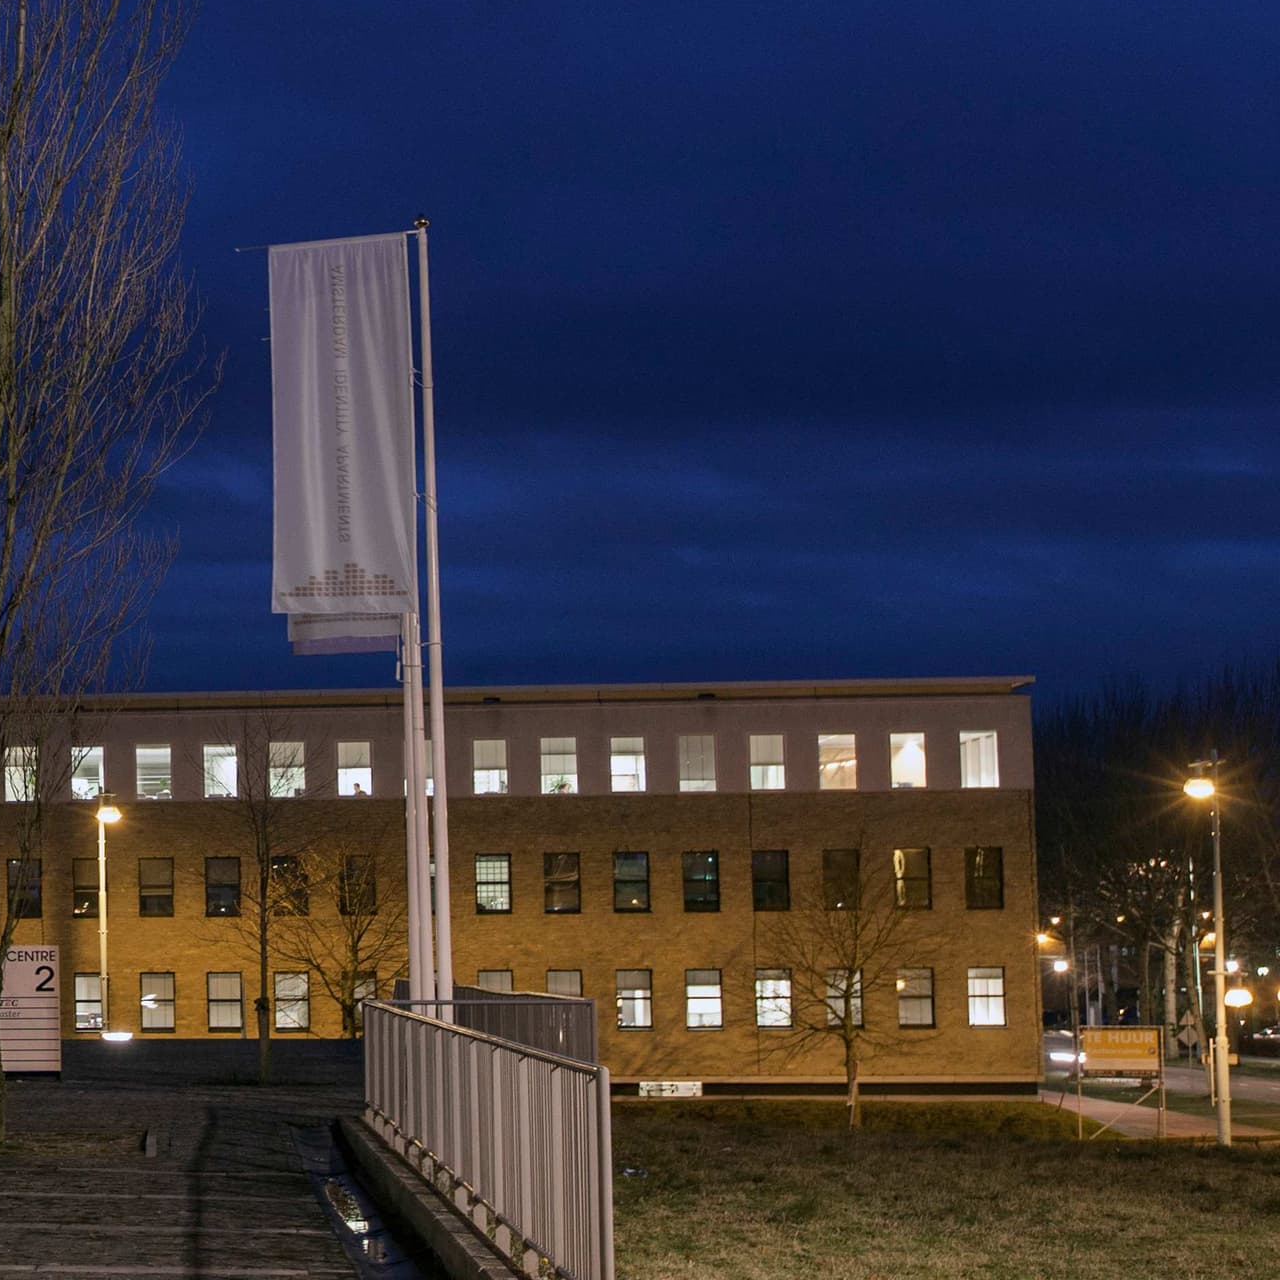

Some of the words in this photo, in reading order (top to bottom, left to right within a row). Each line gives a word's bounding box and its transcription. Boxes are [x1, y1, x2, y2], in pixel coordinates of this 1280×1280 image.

[7, 950, 56, 962] CENTRE
[35, 965, 55, 992] 2
[1108, 1030, 1154, 1044] HUUR
